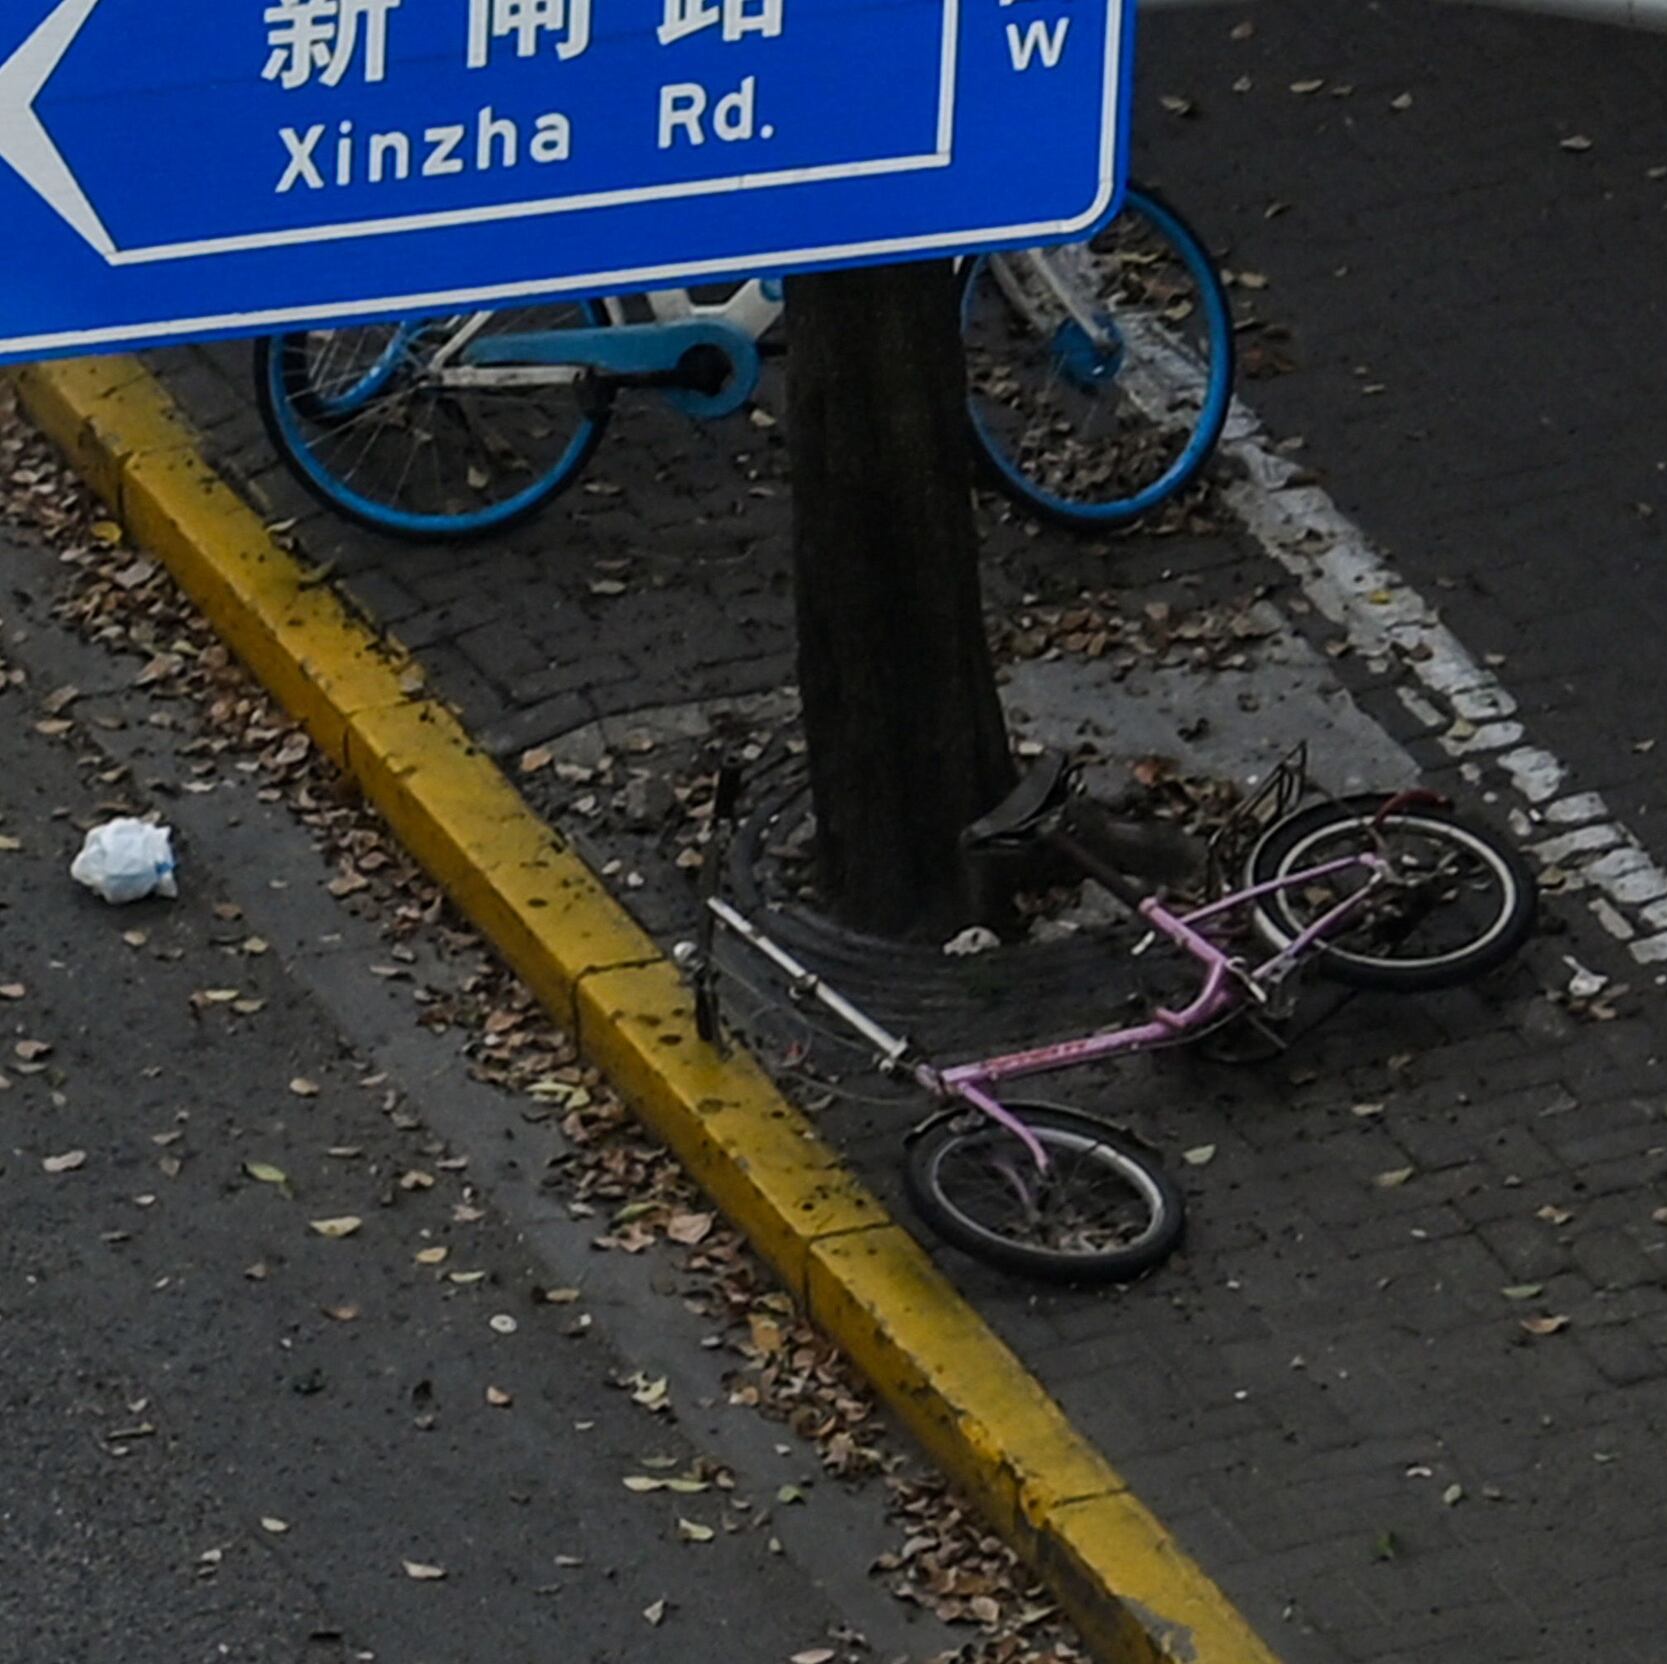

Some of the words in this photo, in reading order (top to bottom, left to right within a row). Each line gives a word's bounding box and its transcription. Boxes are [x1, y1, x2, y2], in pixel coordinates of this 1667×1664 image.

[1006, 16, 1070, 72] W
[275, 106, 571, 193] Xinzha
[657, 76, 775, 149] Rd.
